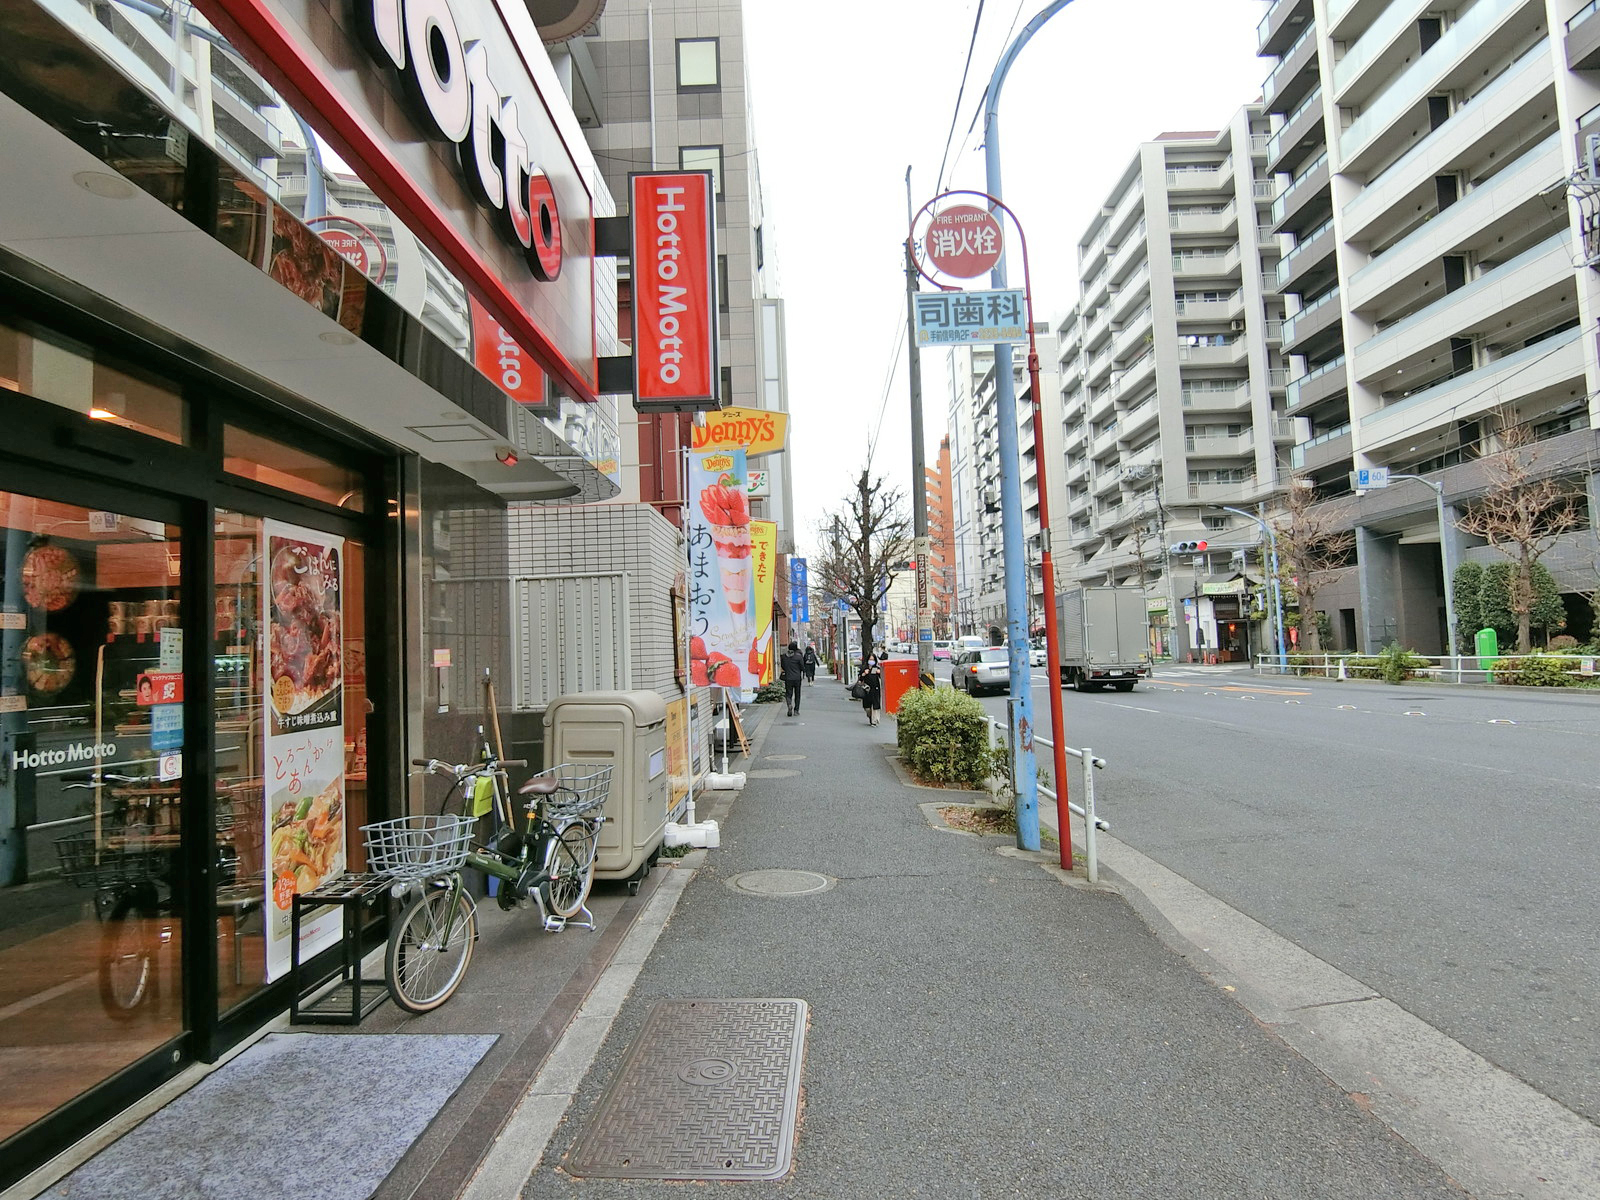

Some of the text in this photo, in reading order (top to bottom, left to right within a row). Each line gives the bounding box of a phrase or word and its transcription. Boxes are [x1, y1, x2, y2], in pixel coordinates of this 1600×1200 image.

[936, 213, 988, 225] FIRE HYDRANT
[932, 226, 997, 258] 消火栓
[656, 187, 687, 384] Hotto Motto
[918, 294, 1021, 327] 司歯科
[693, 414, 775, 449] Denny's
[291, 546, 337, 576] ごはんに
[757, 541, 769, 583] できたて
[316, 575, 339, 596] しみる
[690, 524, 715, 637] あまおう
[12, 742, 116, 770] Hotto Motto
